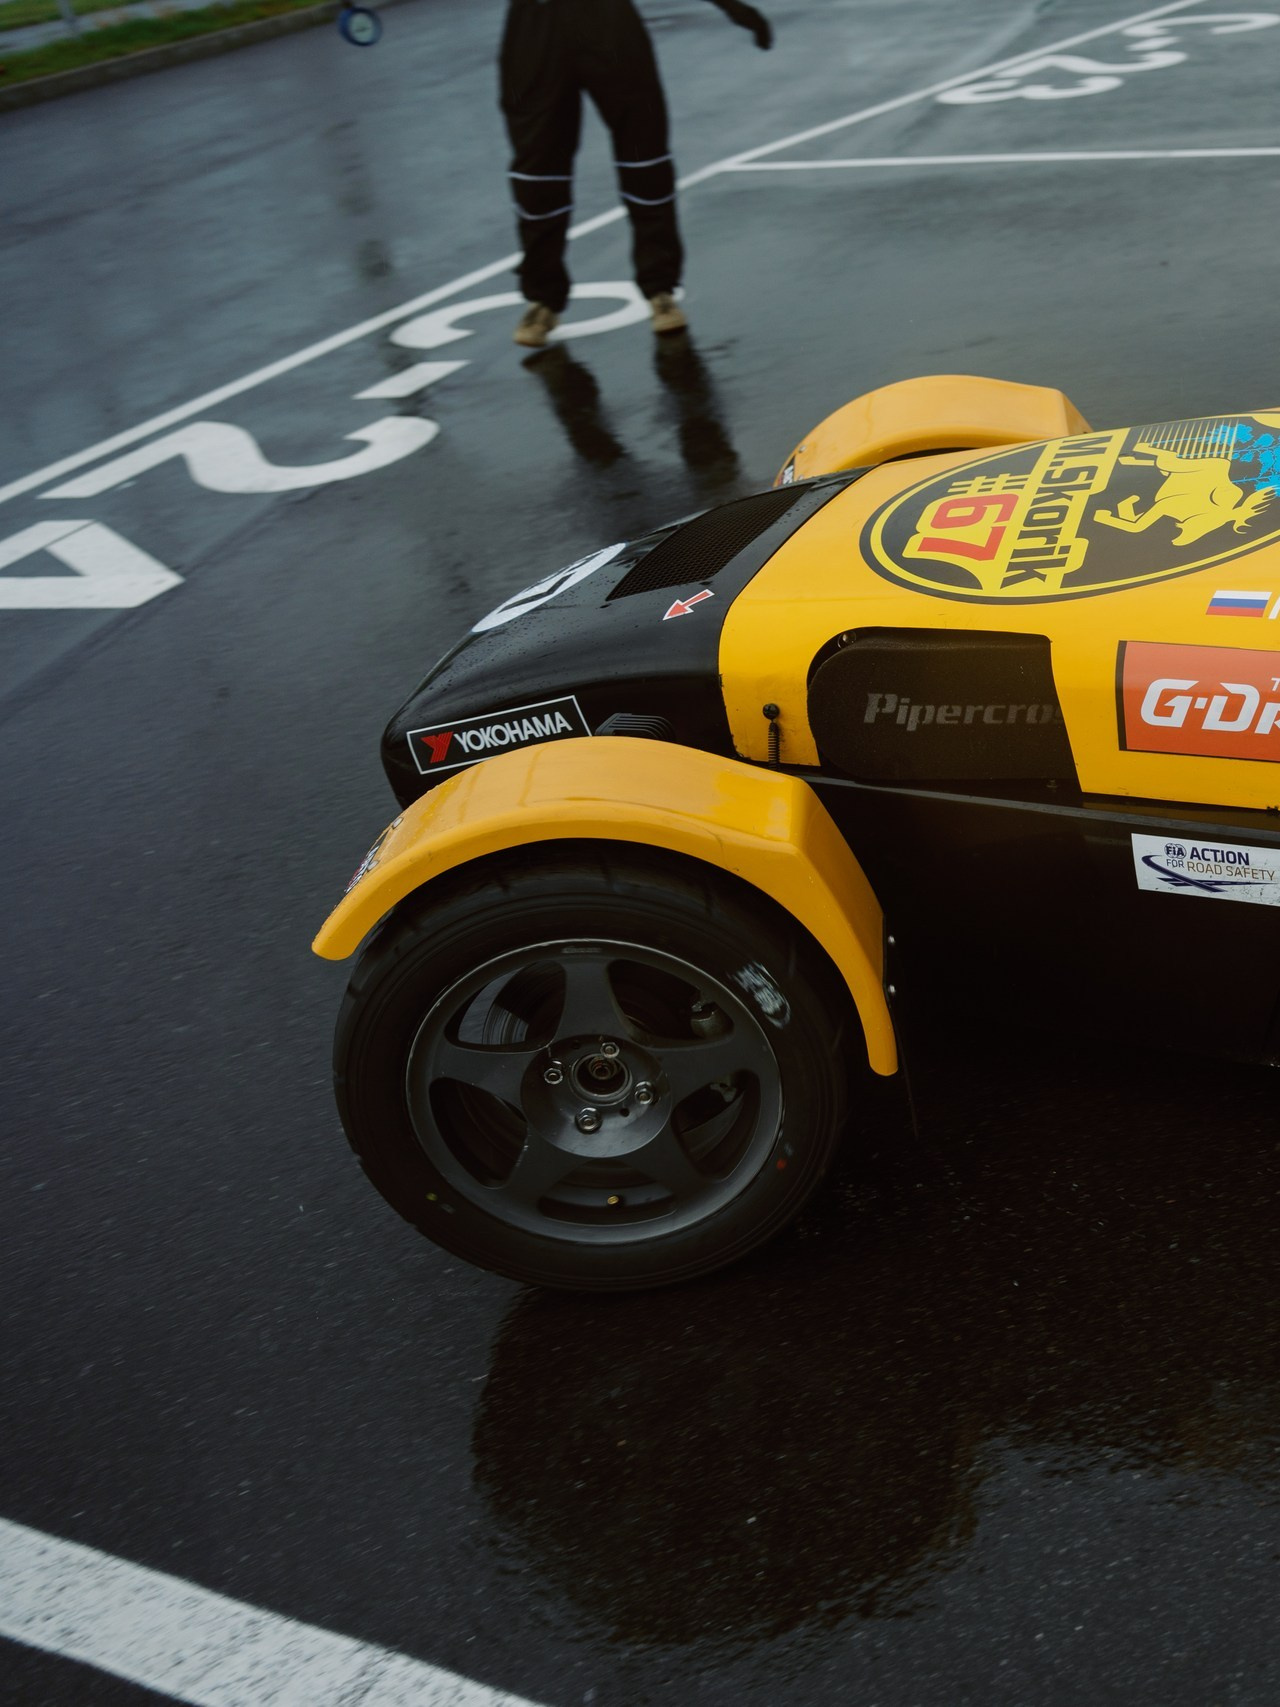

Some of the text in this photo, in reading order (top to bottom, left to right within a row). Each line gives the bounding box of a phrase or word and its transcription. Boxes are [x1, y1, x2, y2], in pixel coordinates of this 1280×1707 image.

[917, 472, 1032, 561] #67
[999, 434, 1114, 589] M.Skorik
[453, 711, 573, 753] YOKOHAMA
[1166, 858, 1275, 881] FOR ROAD SAFETY
[1189, 847, 1250, 866] ACTION
